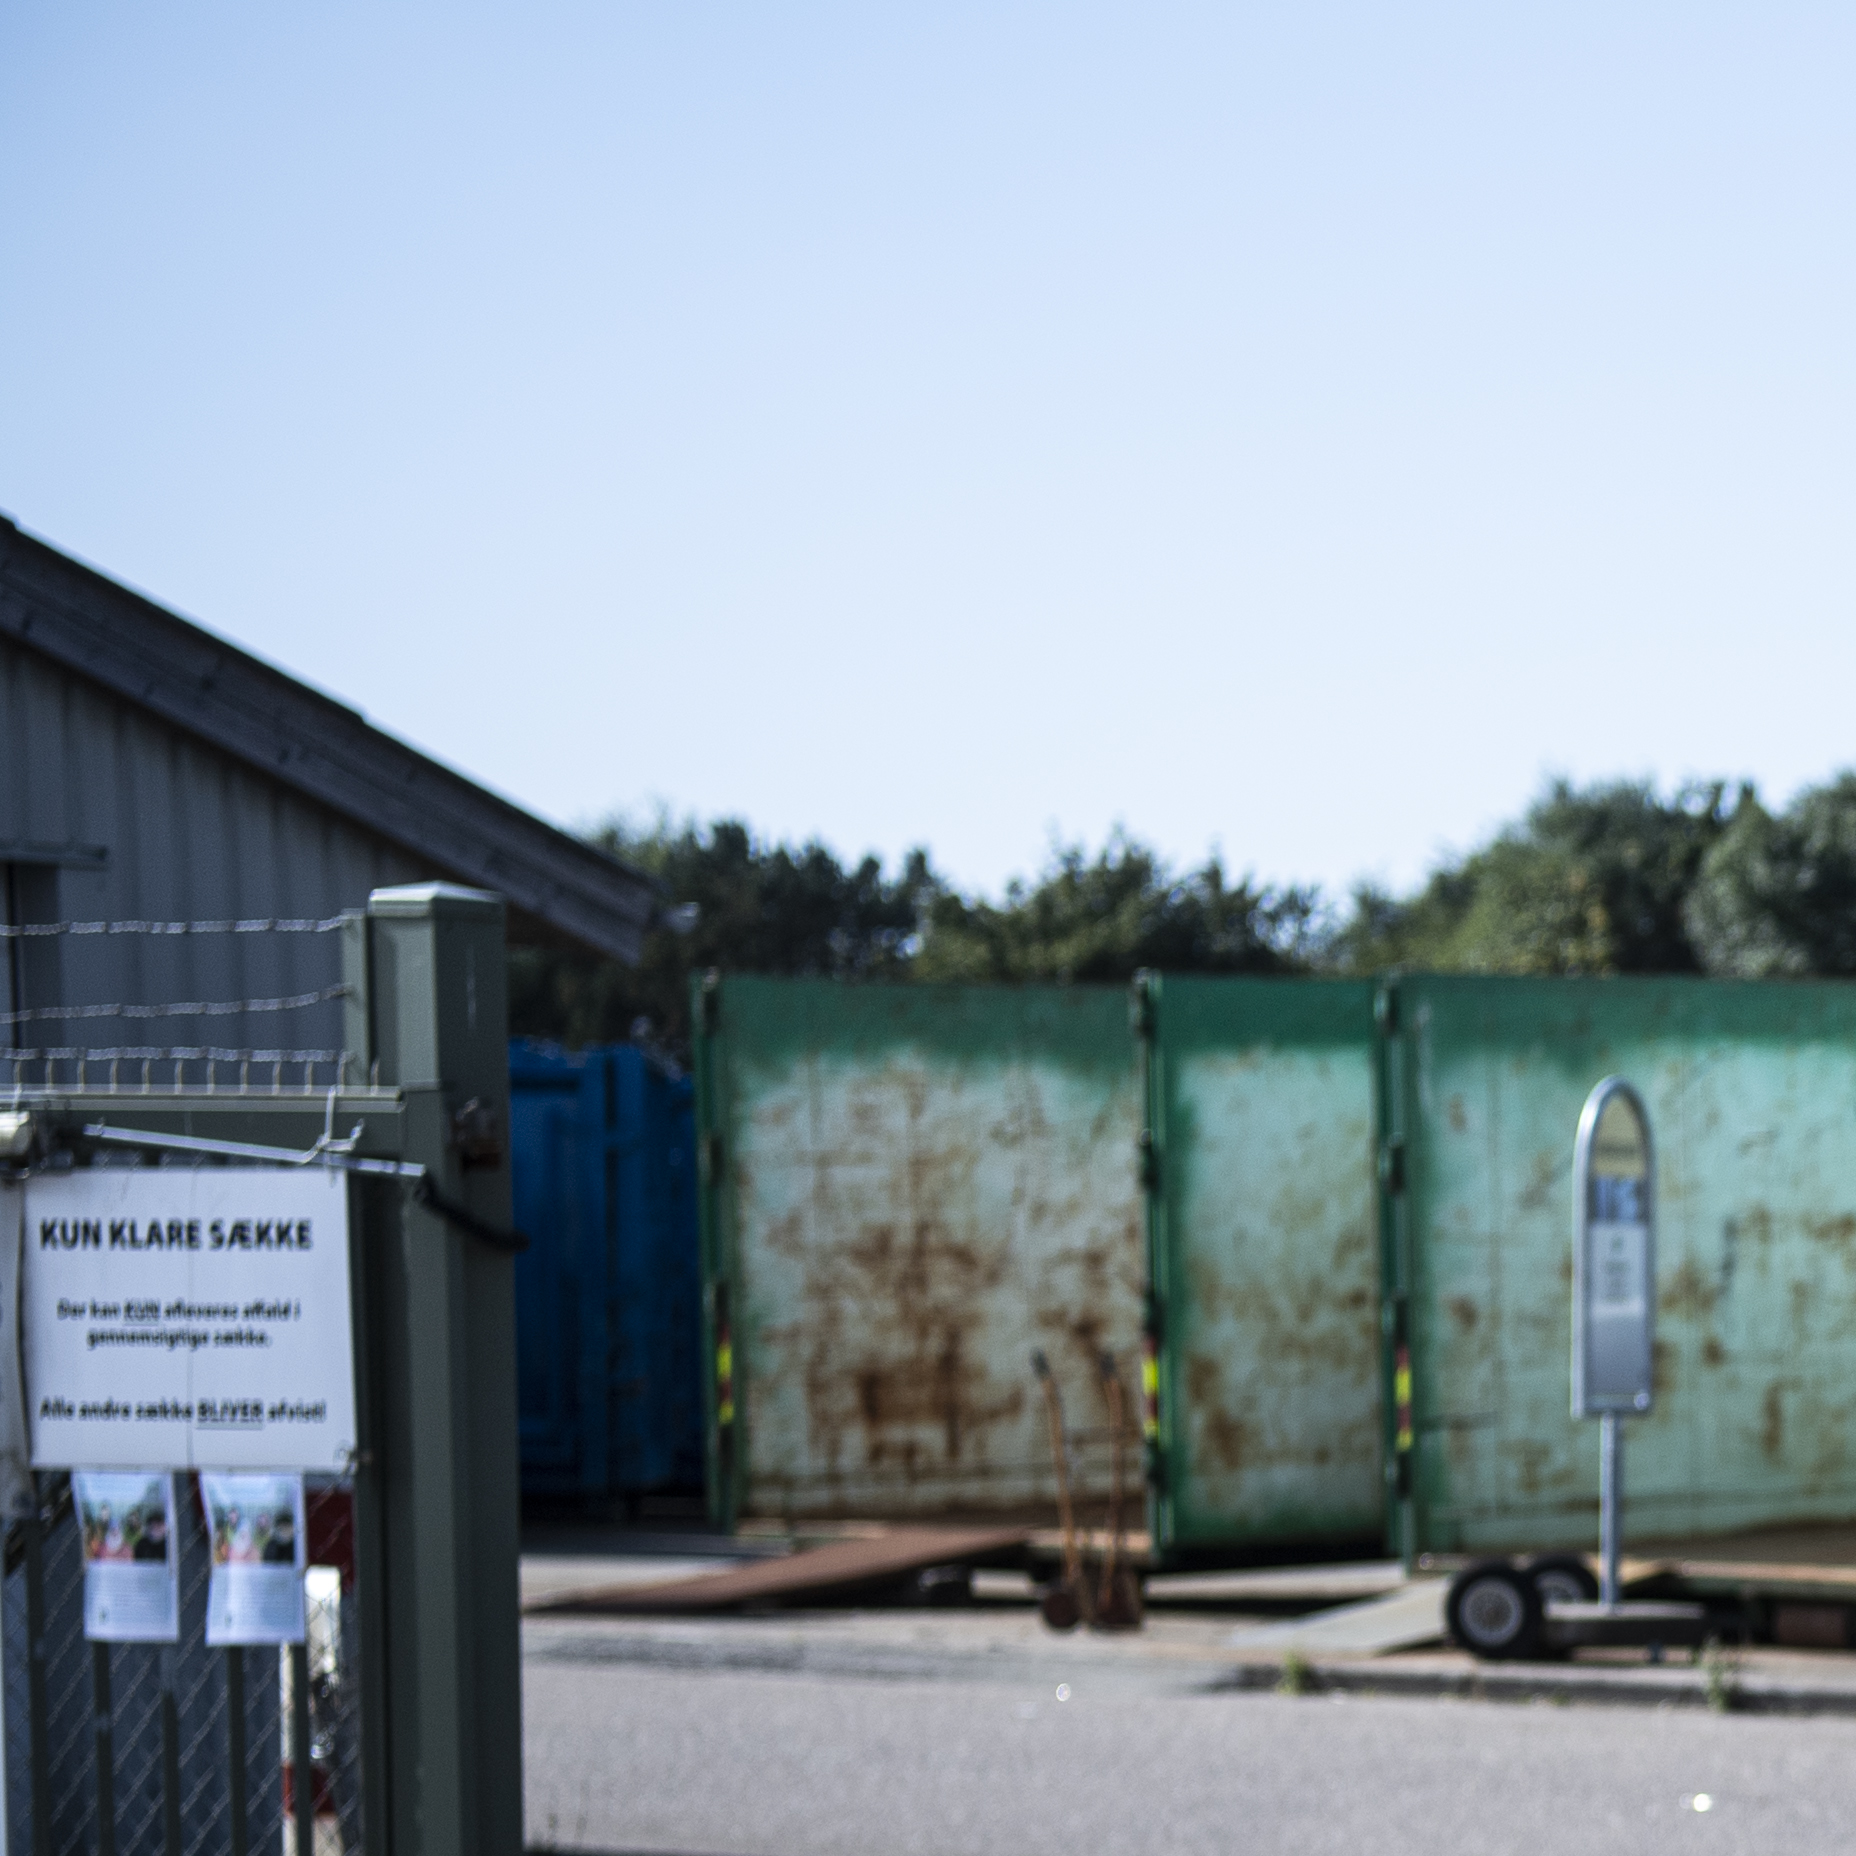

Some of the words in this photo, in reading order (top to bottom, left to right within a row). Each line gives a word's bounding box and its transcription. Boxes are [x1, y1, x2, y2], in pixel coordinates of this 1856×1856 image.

[39, 1217, 101, 1249] KUN
[108, 1217, 202, 1250] KLARE
[208, 1217, 313, 1251] SÆKKE
